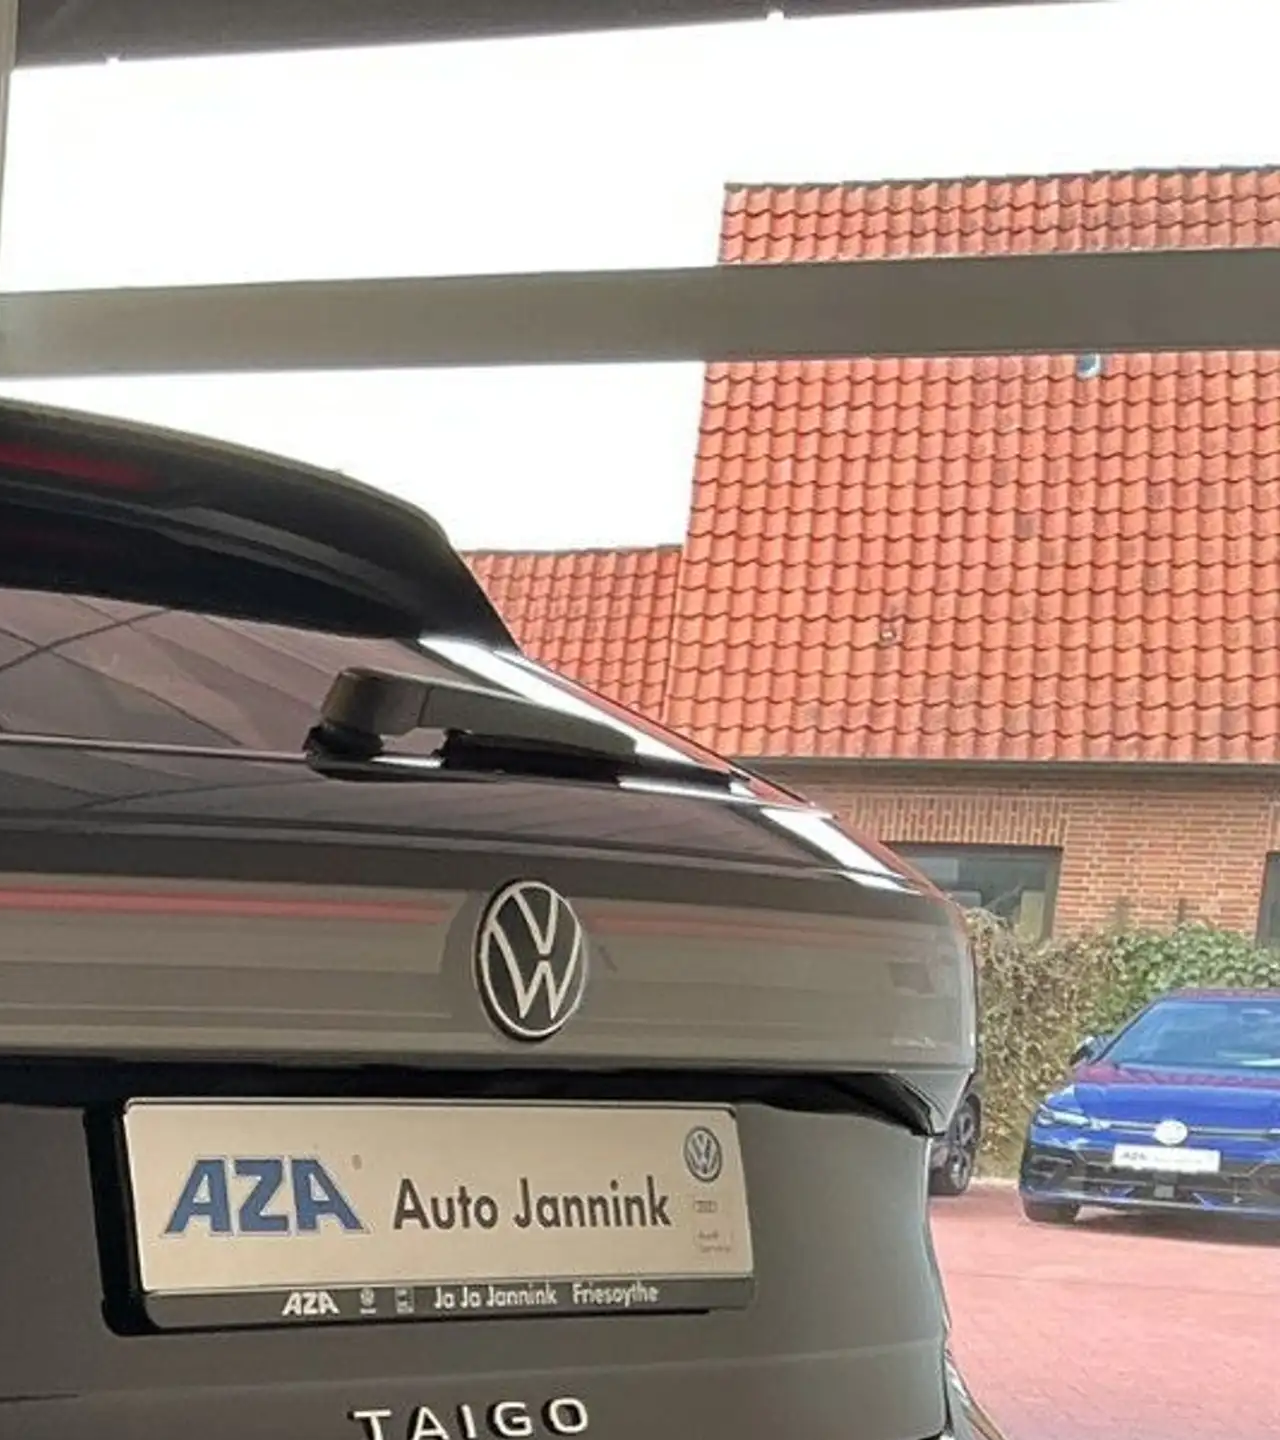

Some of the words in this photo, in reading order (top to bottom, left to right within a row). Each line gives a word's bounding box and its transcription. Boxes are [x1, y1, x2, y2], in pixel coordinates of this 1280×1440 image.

[160, 1156, 370, 1236] AZA
[393, 1178, 498, 1229] Auto
[513, 1175, 672, 1228] Jannink
[281, 1291, 339, 1316] AZA
[485, 1281, 557, 1307] Jannink
[571, 1281, 658, 1307] Friesoythe
